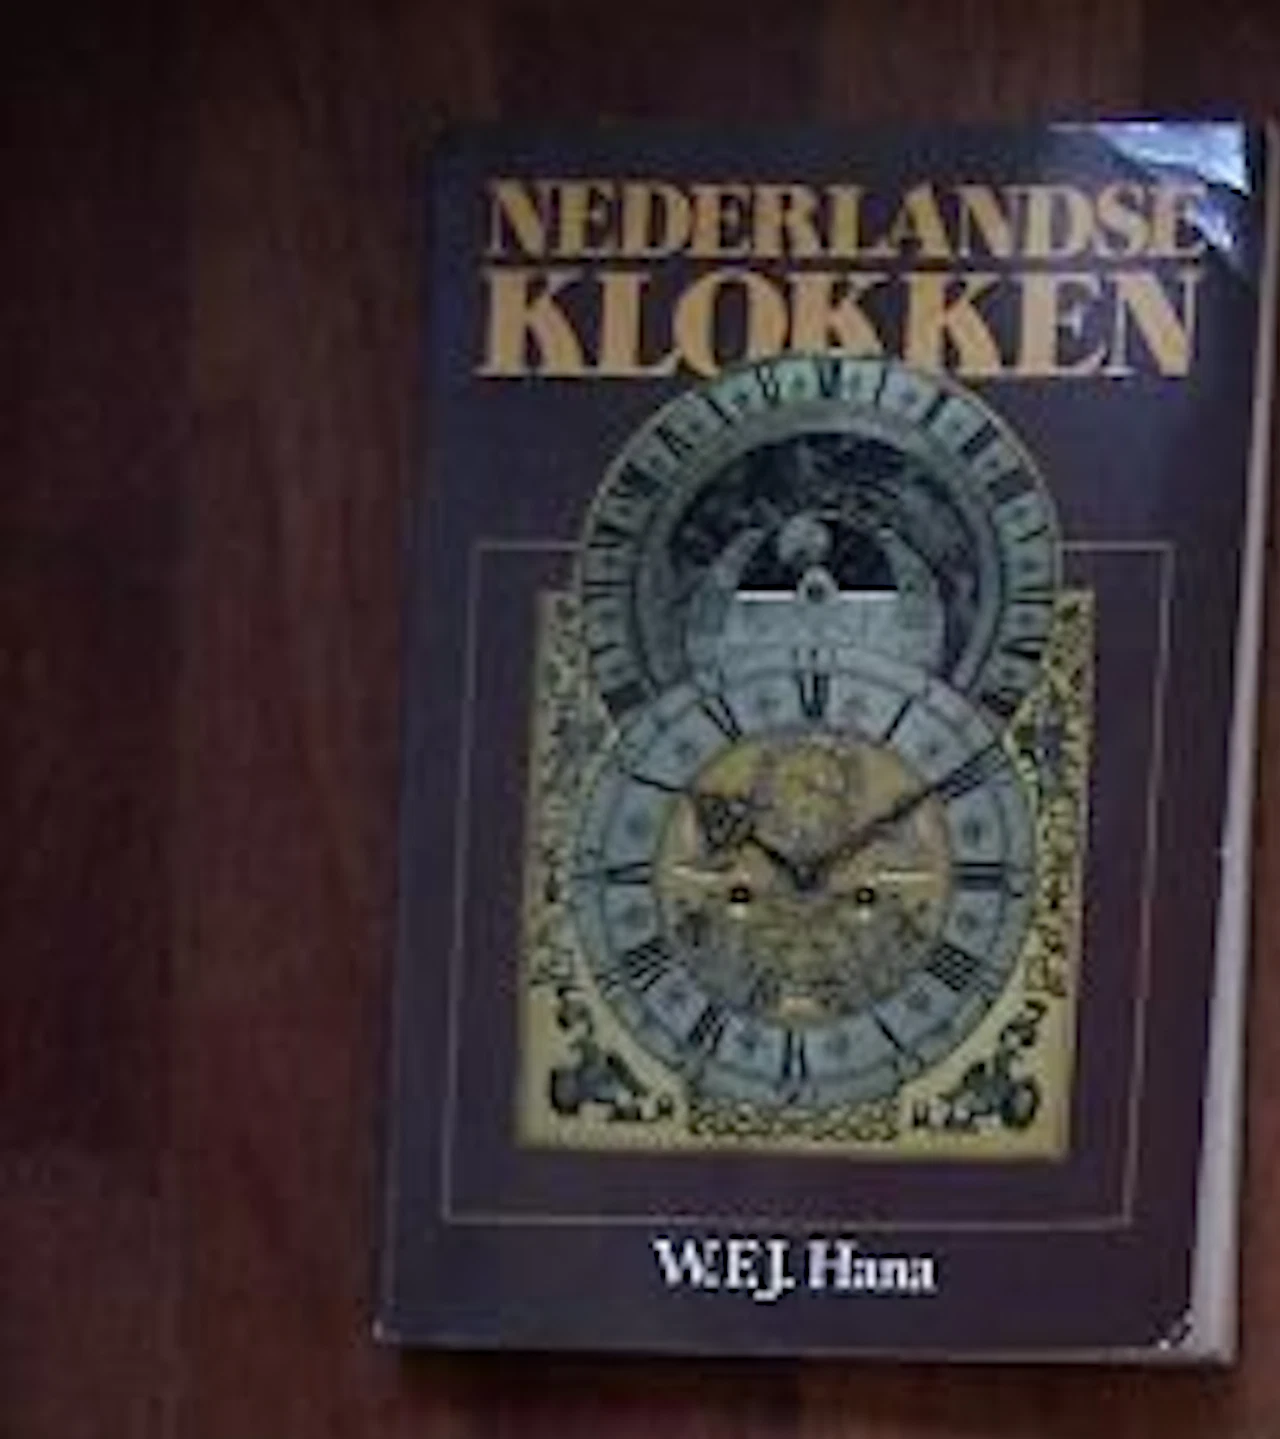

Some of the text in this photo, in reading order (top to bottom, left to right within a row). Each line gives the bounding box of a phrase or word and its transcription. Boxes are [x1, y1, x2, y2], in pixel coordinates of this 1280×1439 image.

[487, 178, 1213, 260] NEDERLANDSE
[475, 265, 1204, 378] KLOKKEN
[806, 1236, 938, 1292] Hana
